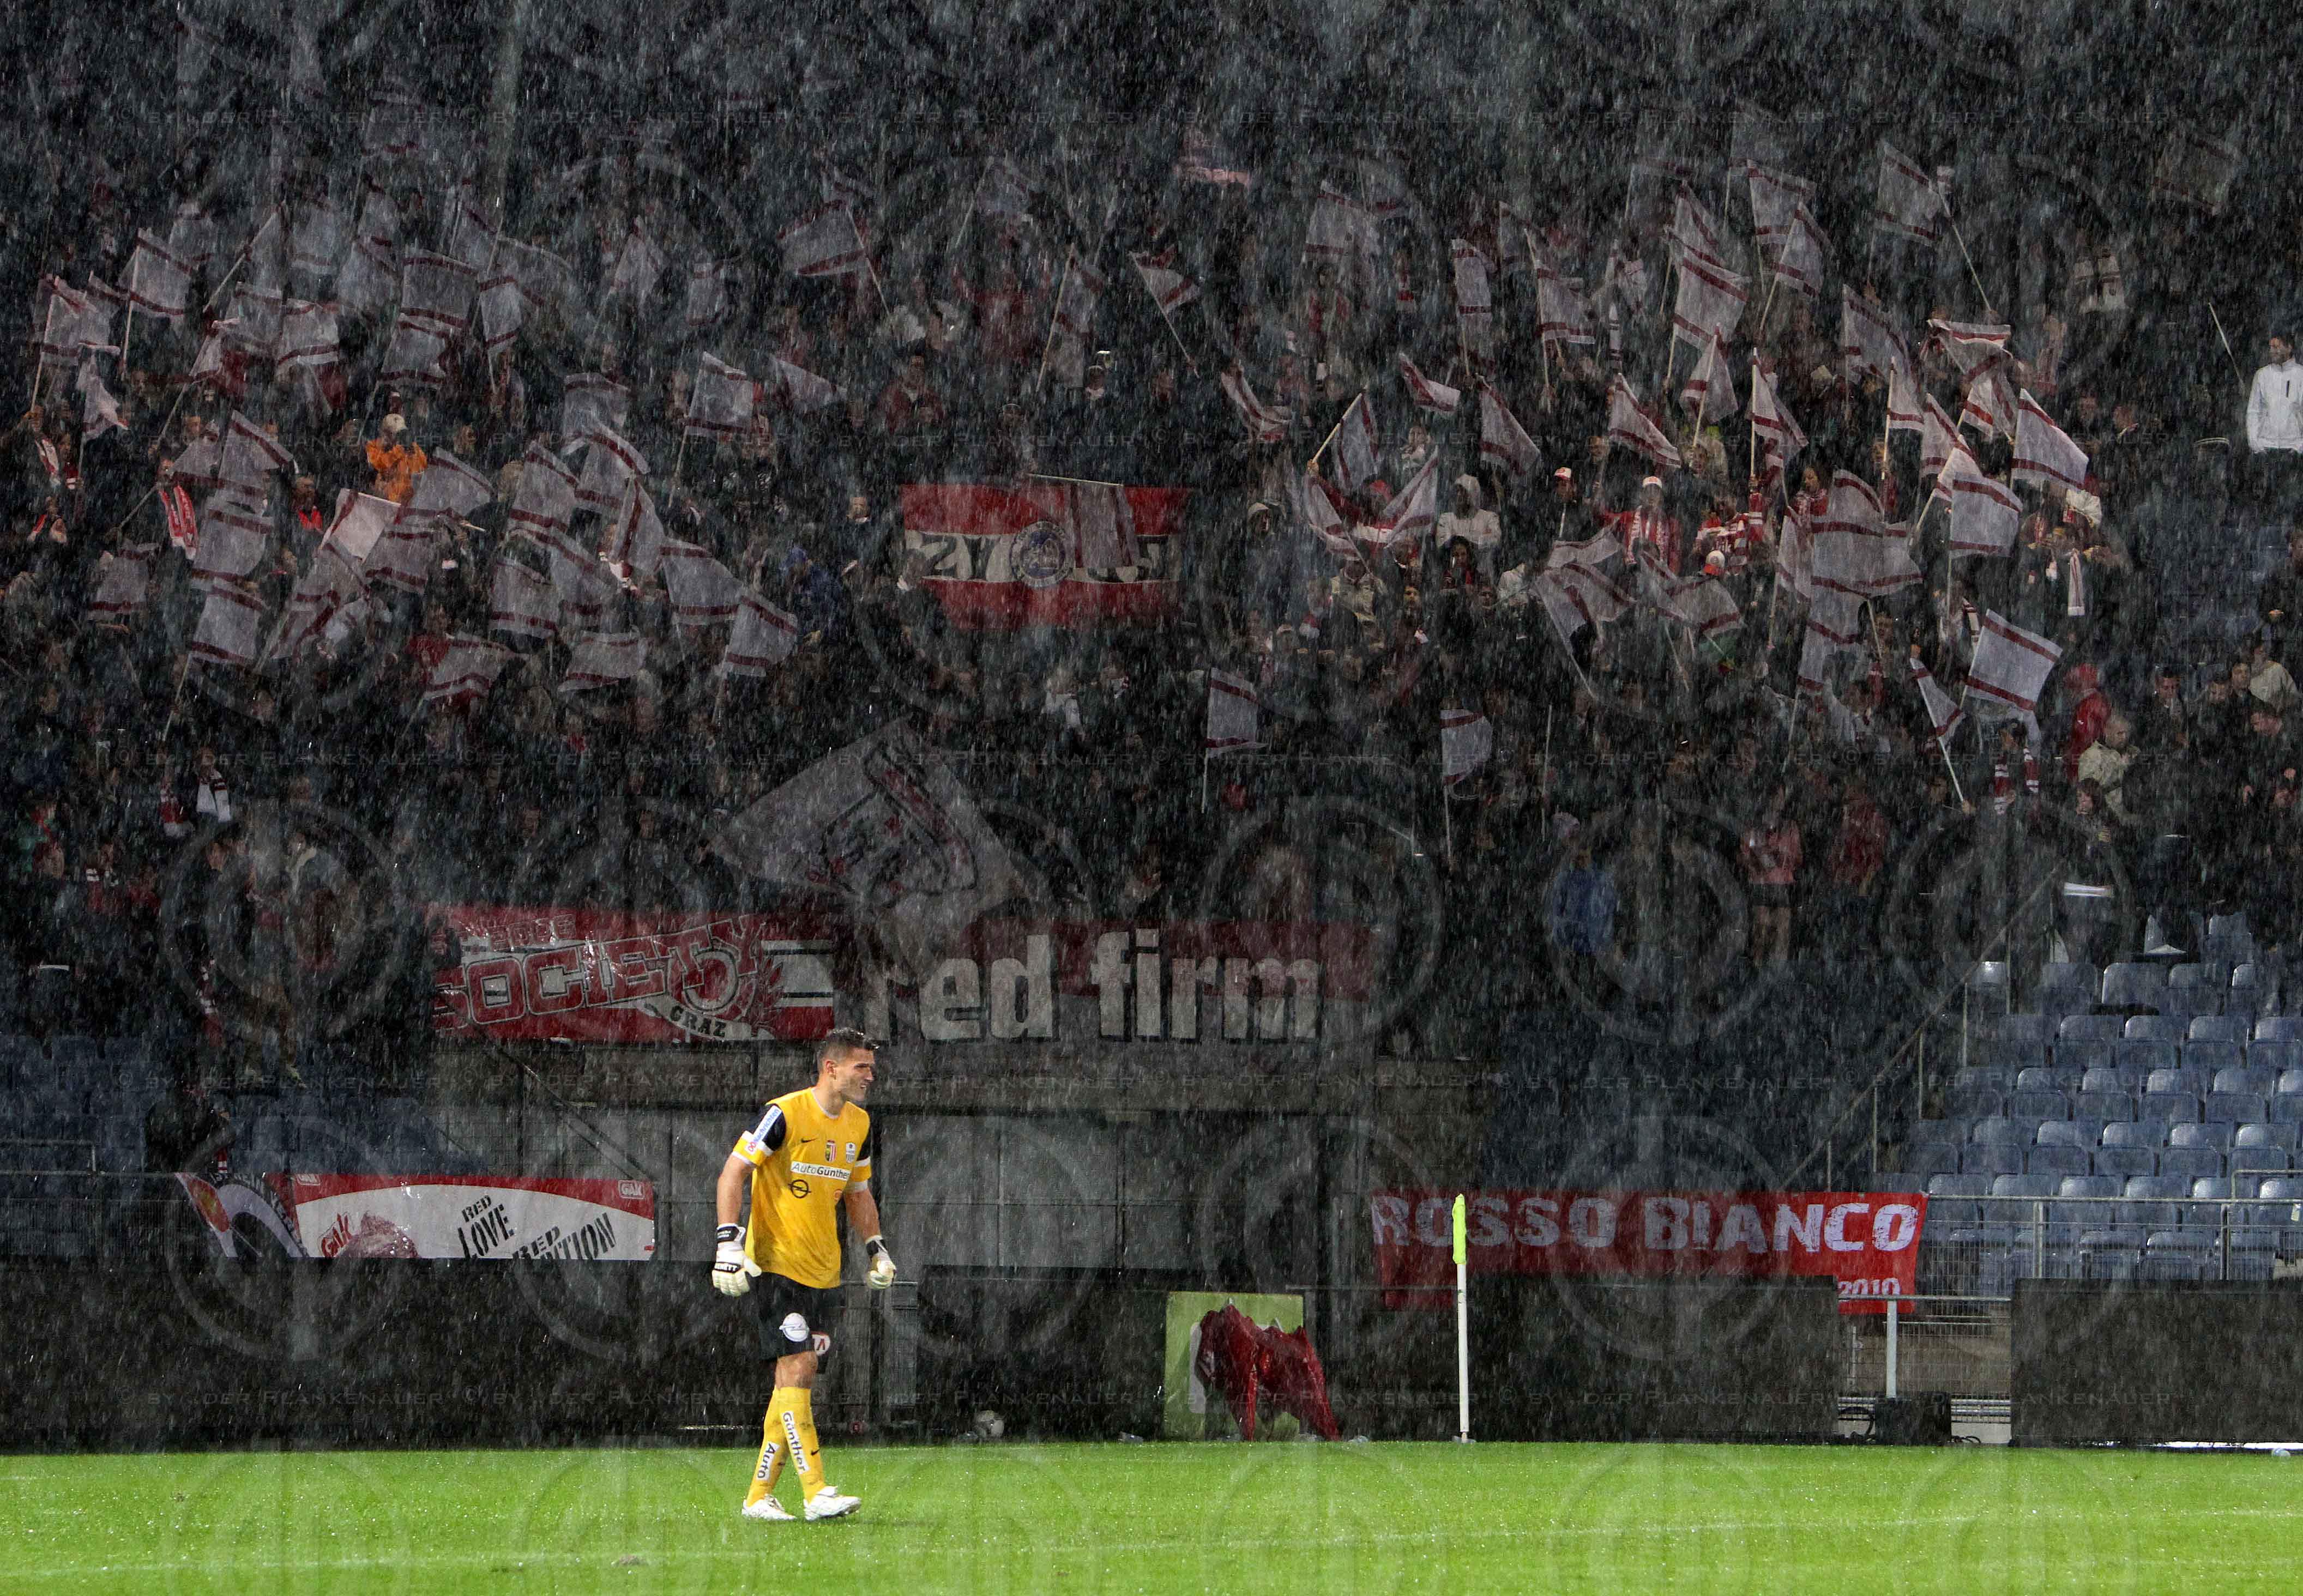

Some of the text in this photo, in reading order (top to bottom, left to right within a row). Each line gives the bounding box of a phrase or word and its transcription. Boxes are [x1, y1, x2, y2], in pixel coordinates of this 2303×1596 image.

[863, 928, 1320, 1039] red firm
[670, 1005, 726, 1037] GRAZ
[462, 1195, 491, 1222] RED
[1371, 1196, 1919, 1253] ROSSO BIANCO
[1836, 1277, 1901, 1302] 2010
[757, 1443, 776, 1479] Auto
